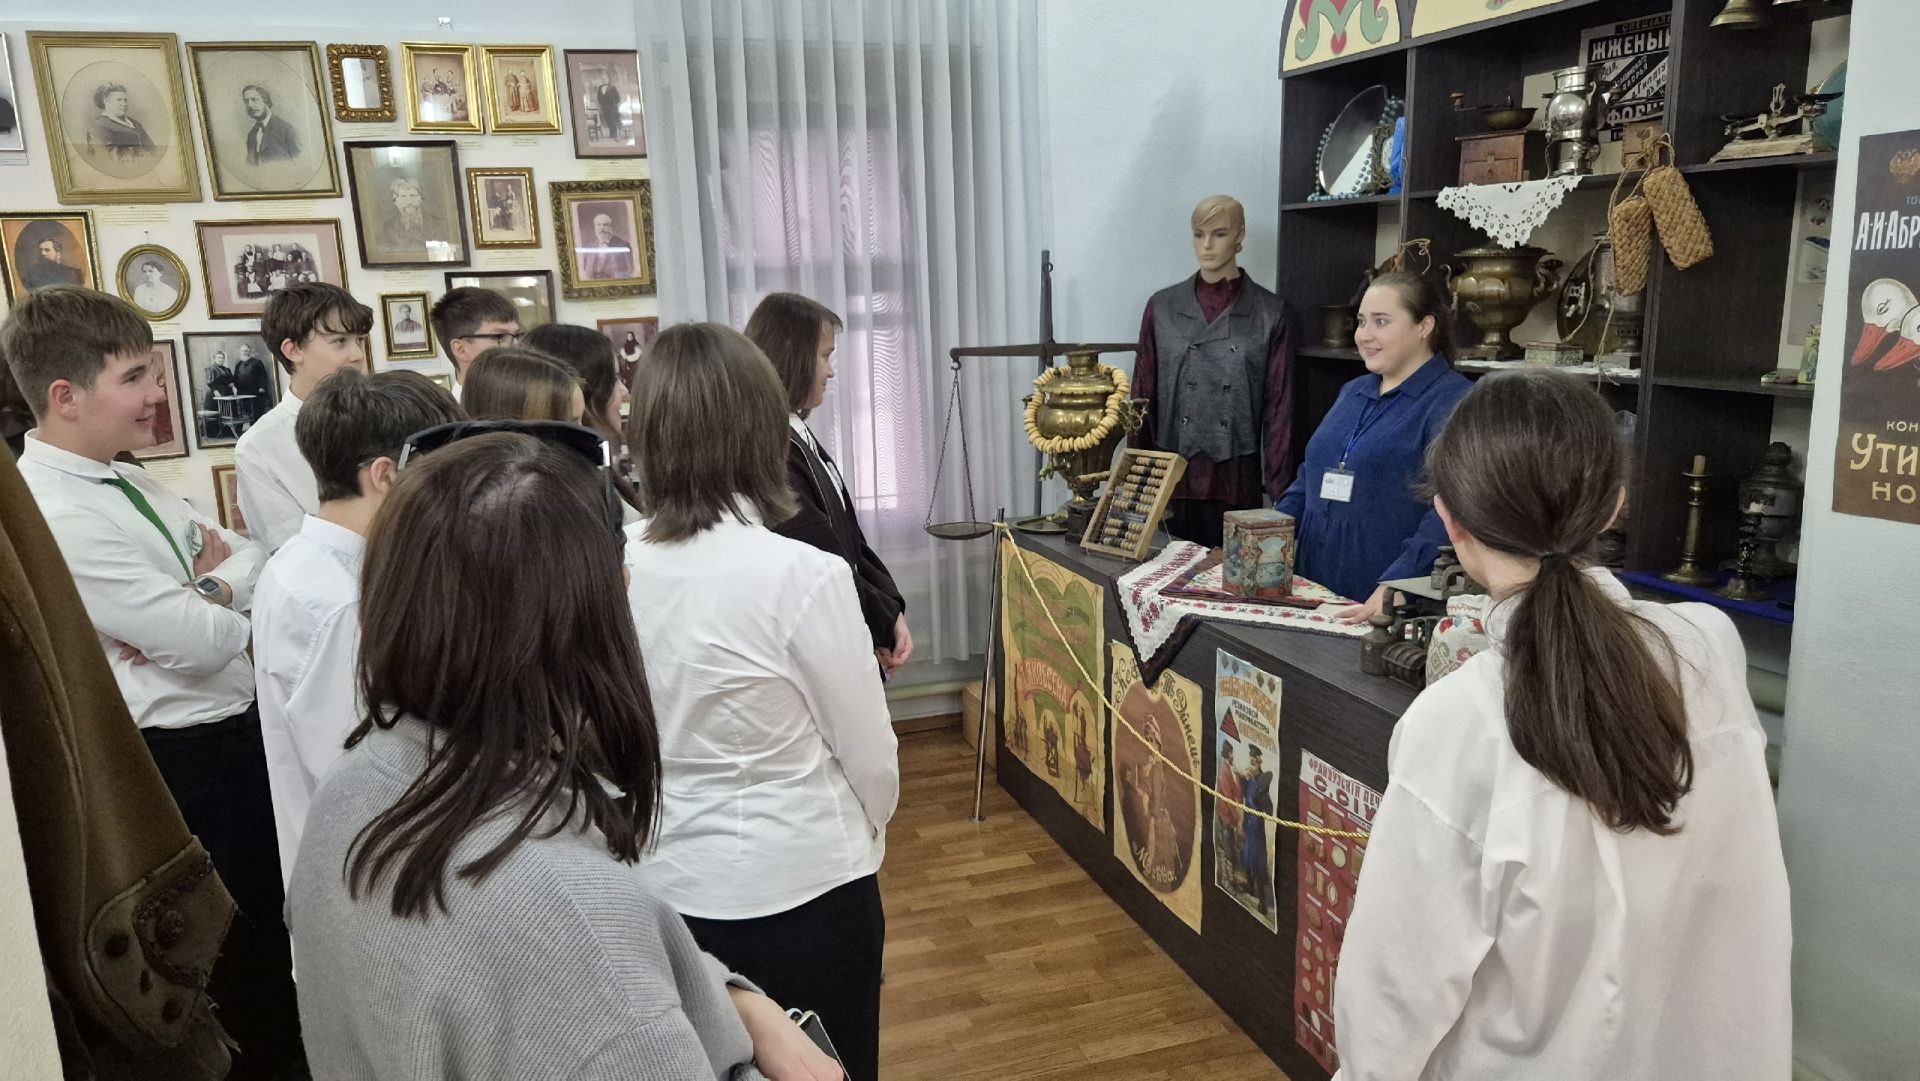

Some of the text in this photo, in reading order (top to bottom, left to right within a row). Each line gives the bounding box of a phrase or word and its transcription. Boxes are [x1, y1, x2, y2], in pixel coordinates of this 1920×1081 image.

[1886, 420, 1919, 432] КОН
[1850, 432, 1919, 476] УТИ
[1871, 481, 1917, 504] НО
